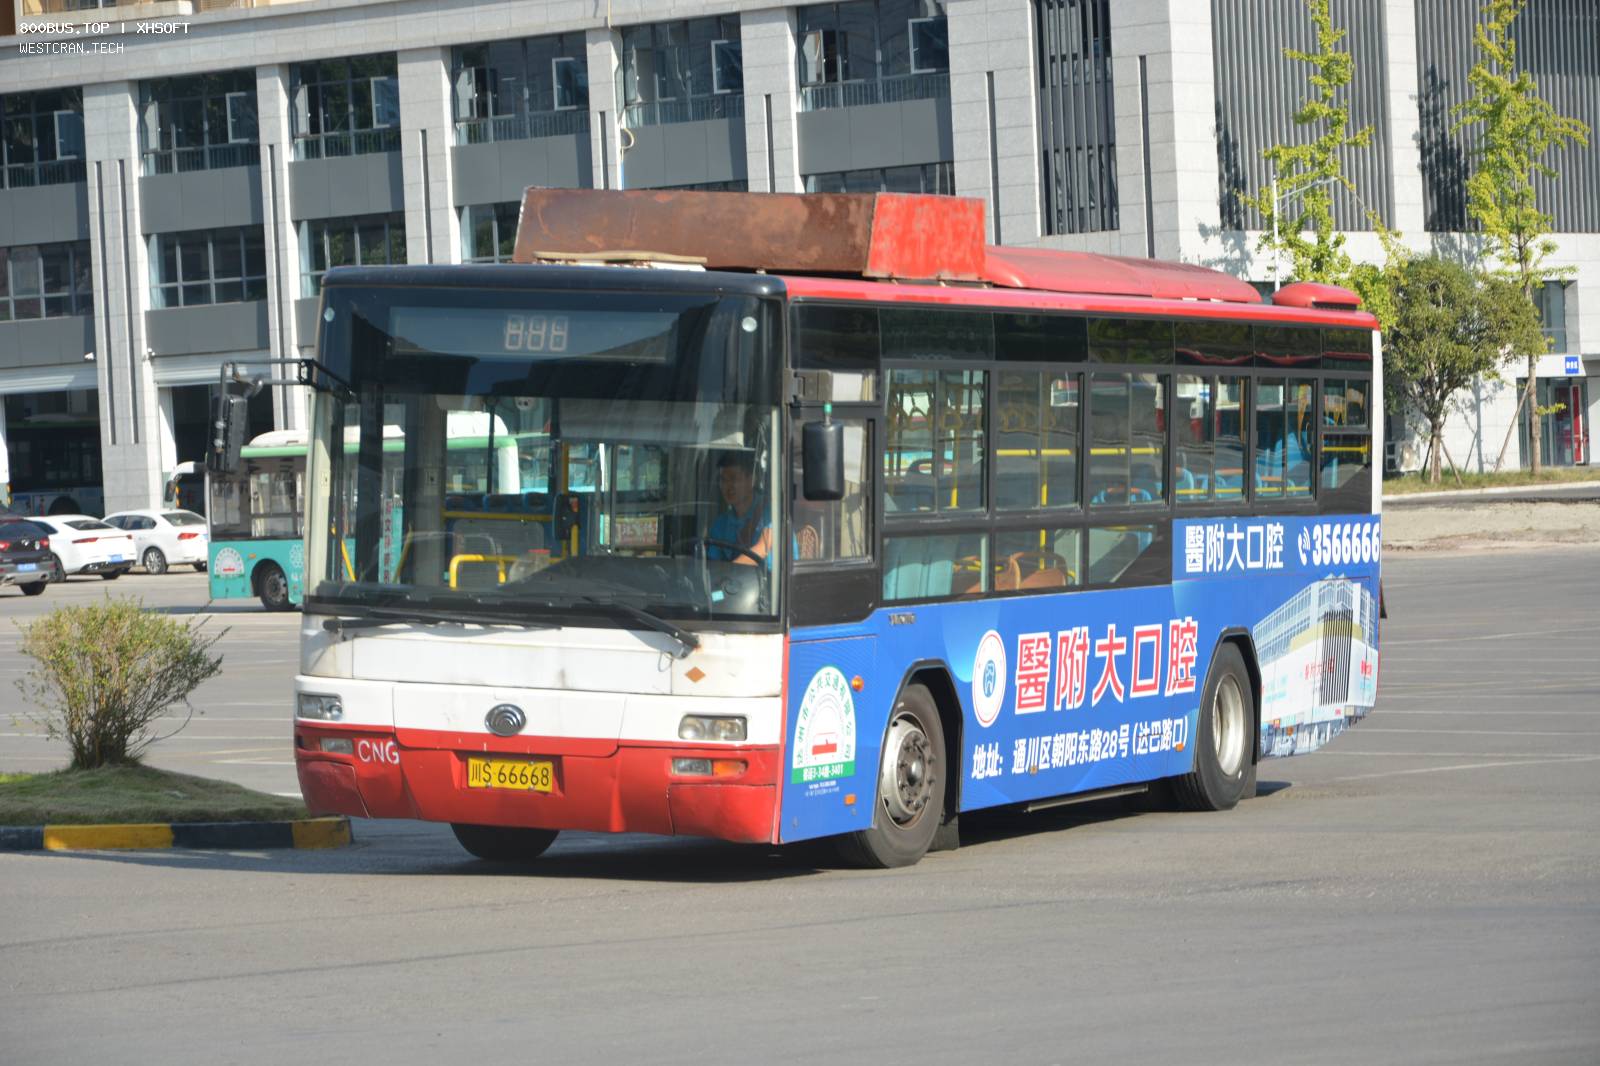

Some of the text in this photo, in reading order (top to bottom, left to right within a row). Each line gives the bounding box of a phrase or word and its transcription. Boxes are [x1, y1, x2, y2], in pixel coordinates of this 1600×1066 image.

[1185, 522, 1285, 573] 醫附大口腔
[1312, 522, 1380, 567] 3566666
[1014, 616, 1199, 715] 醫附大口腔
[357, 740, 400, 765] CNG
